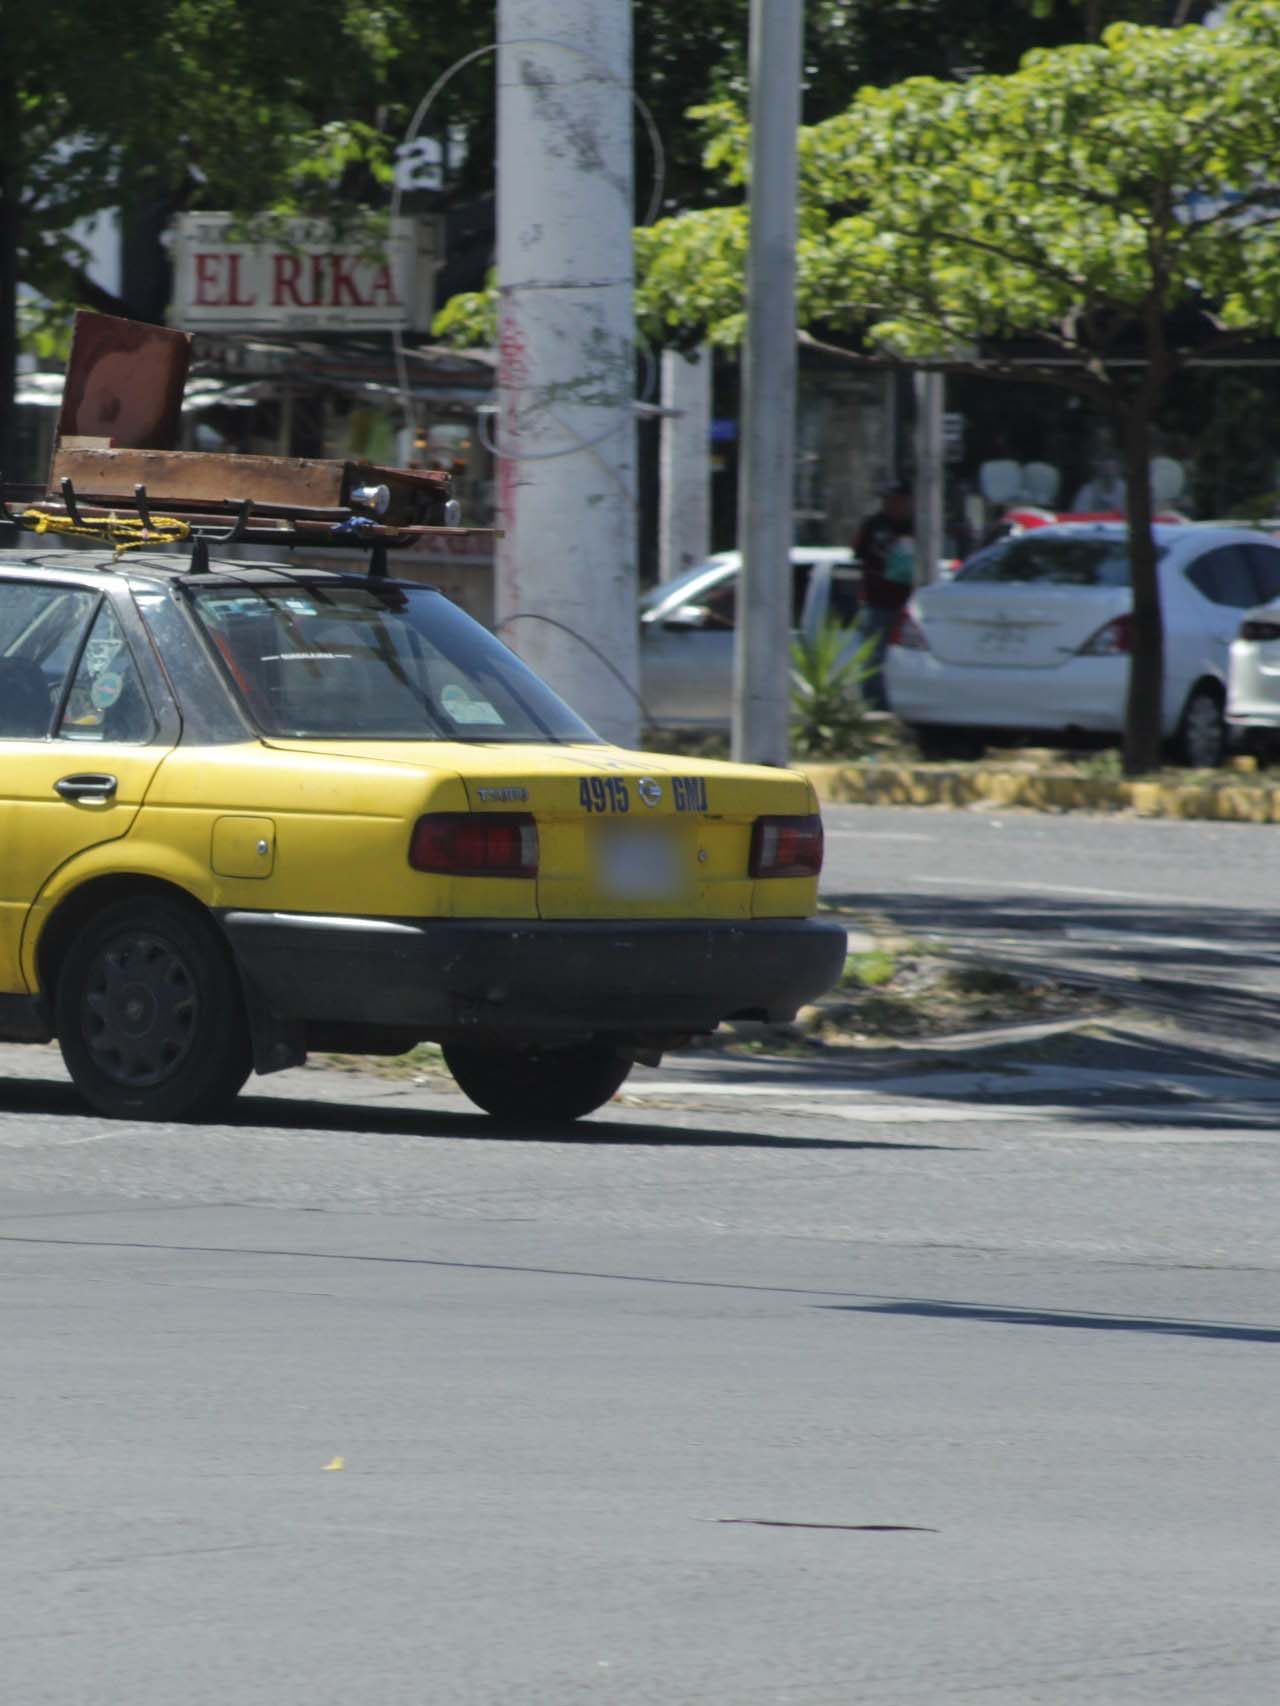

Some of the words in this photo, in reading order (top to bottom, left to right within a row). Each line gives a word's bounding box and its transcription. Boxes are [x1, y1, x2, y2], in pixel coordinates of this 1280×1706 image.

[193, 253, 256, 306] EL
[272, 253, 401, 306] RIKA
[579, 776, 629, 812] 4915
